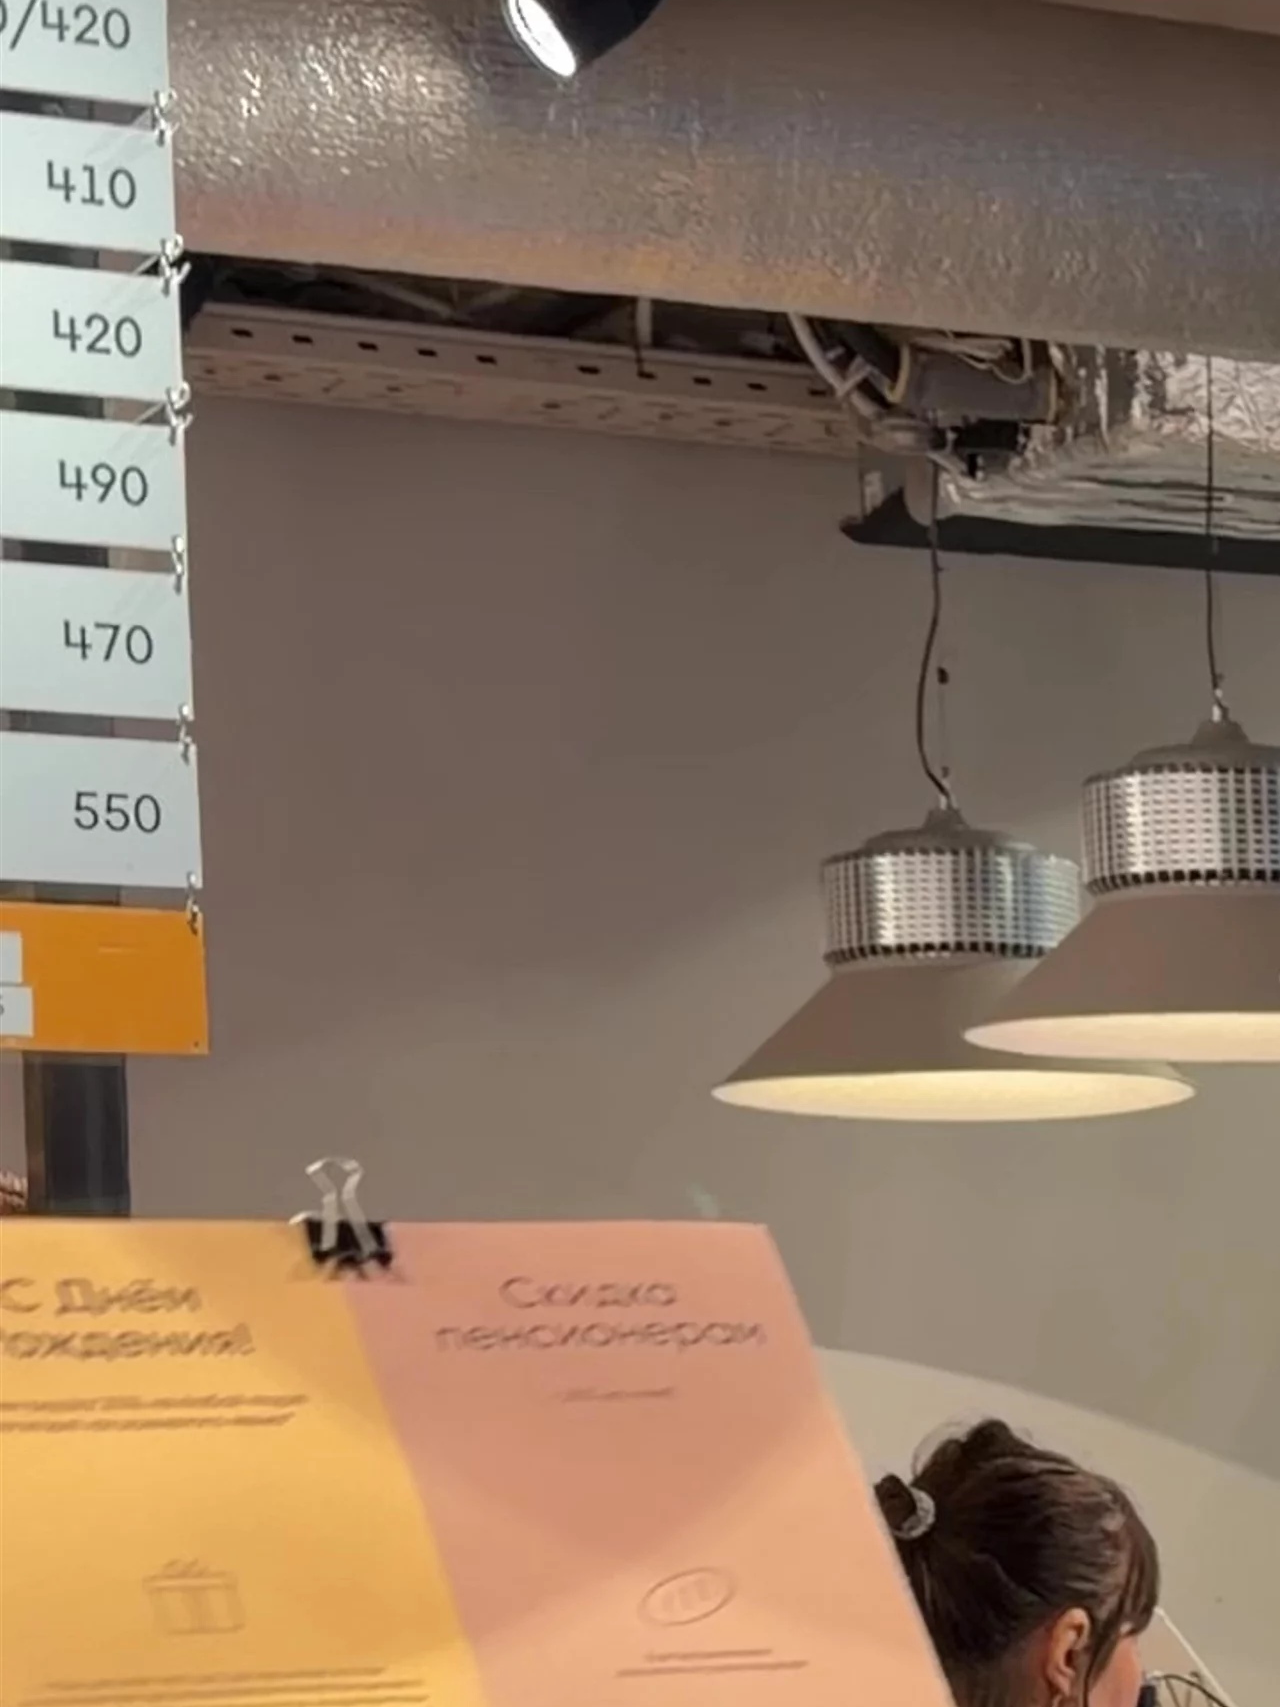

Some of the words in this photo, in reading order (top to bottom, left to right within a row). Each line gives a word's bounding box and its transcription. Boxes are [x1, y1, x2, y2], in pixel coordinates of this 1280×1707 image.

[46, 160, 136, 209] 410
[53, 309, 142, 357] 420
[58, 459, 148, 507] 490
[63, 619, 154, 666] 470
[73, 791, 162, 833] 550
[0, 1322, 255, 1362] ождения!
